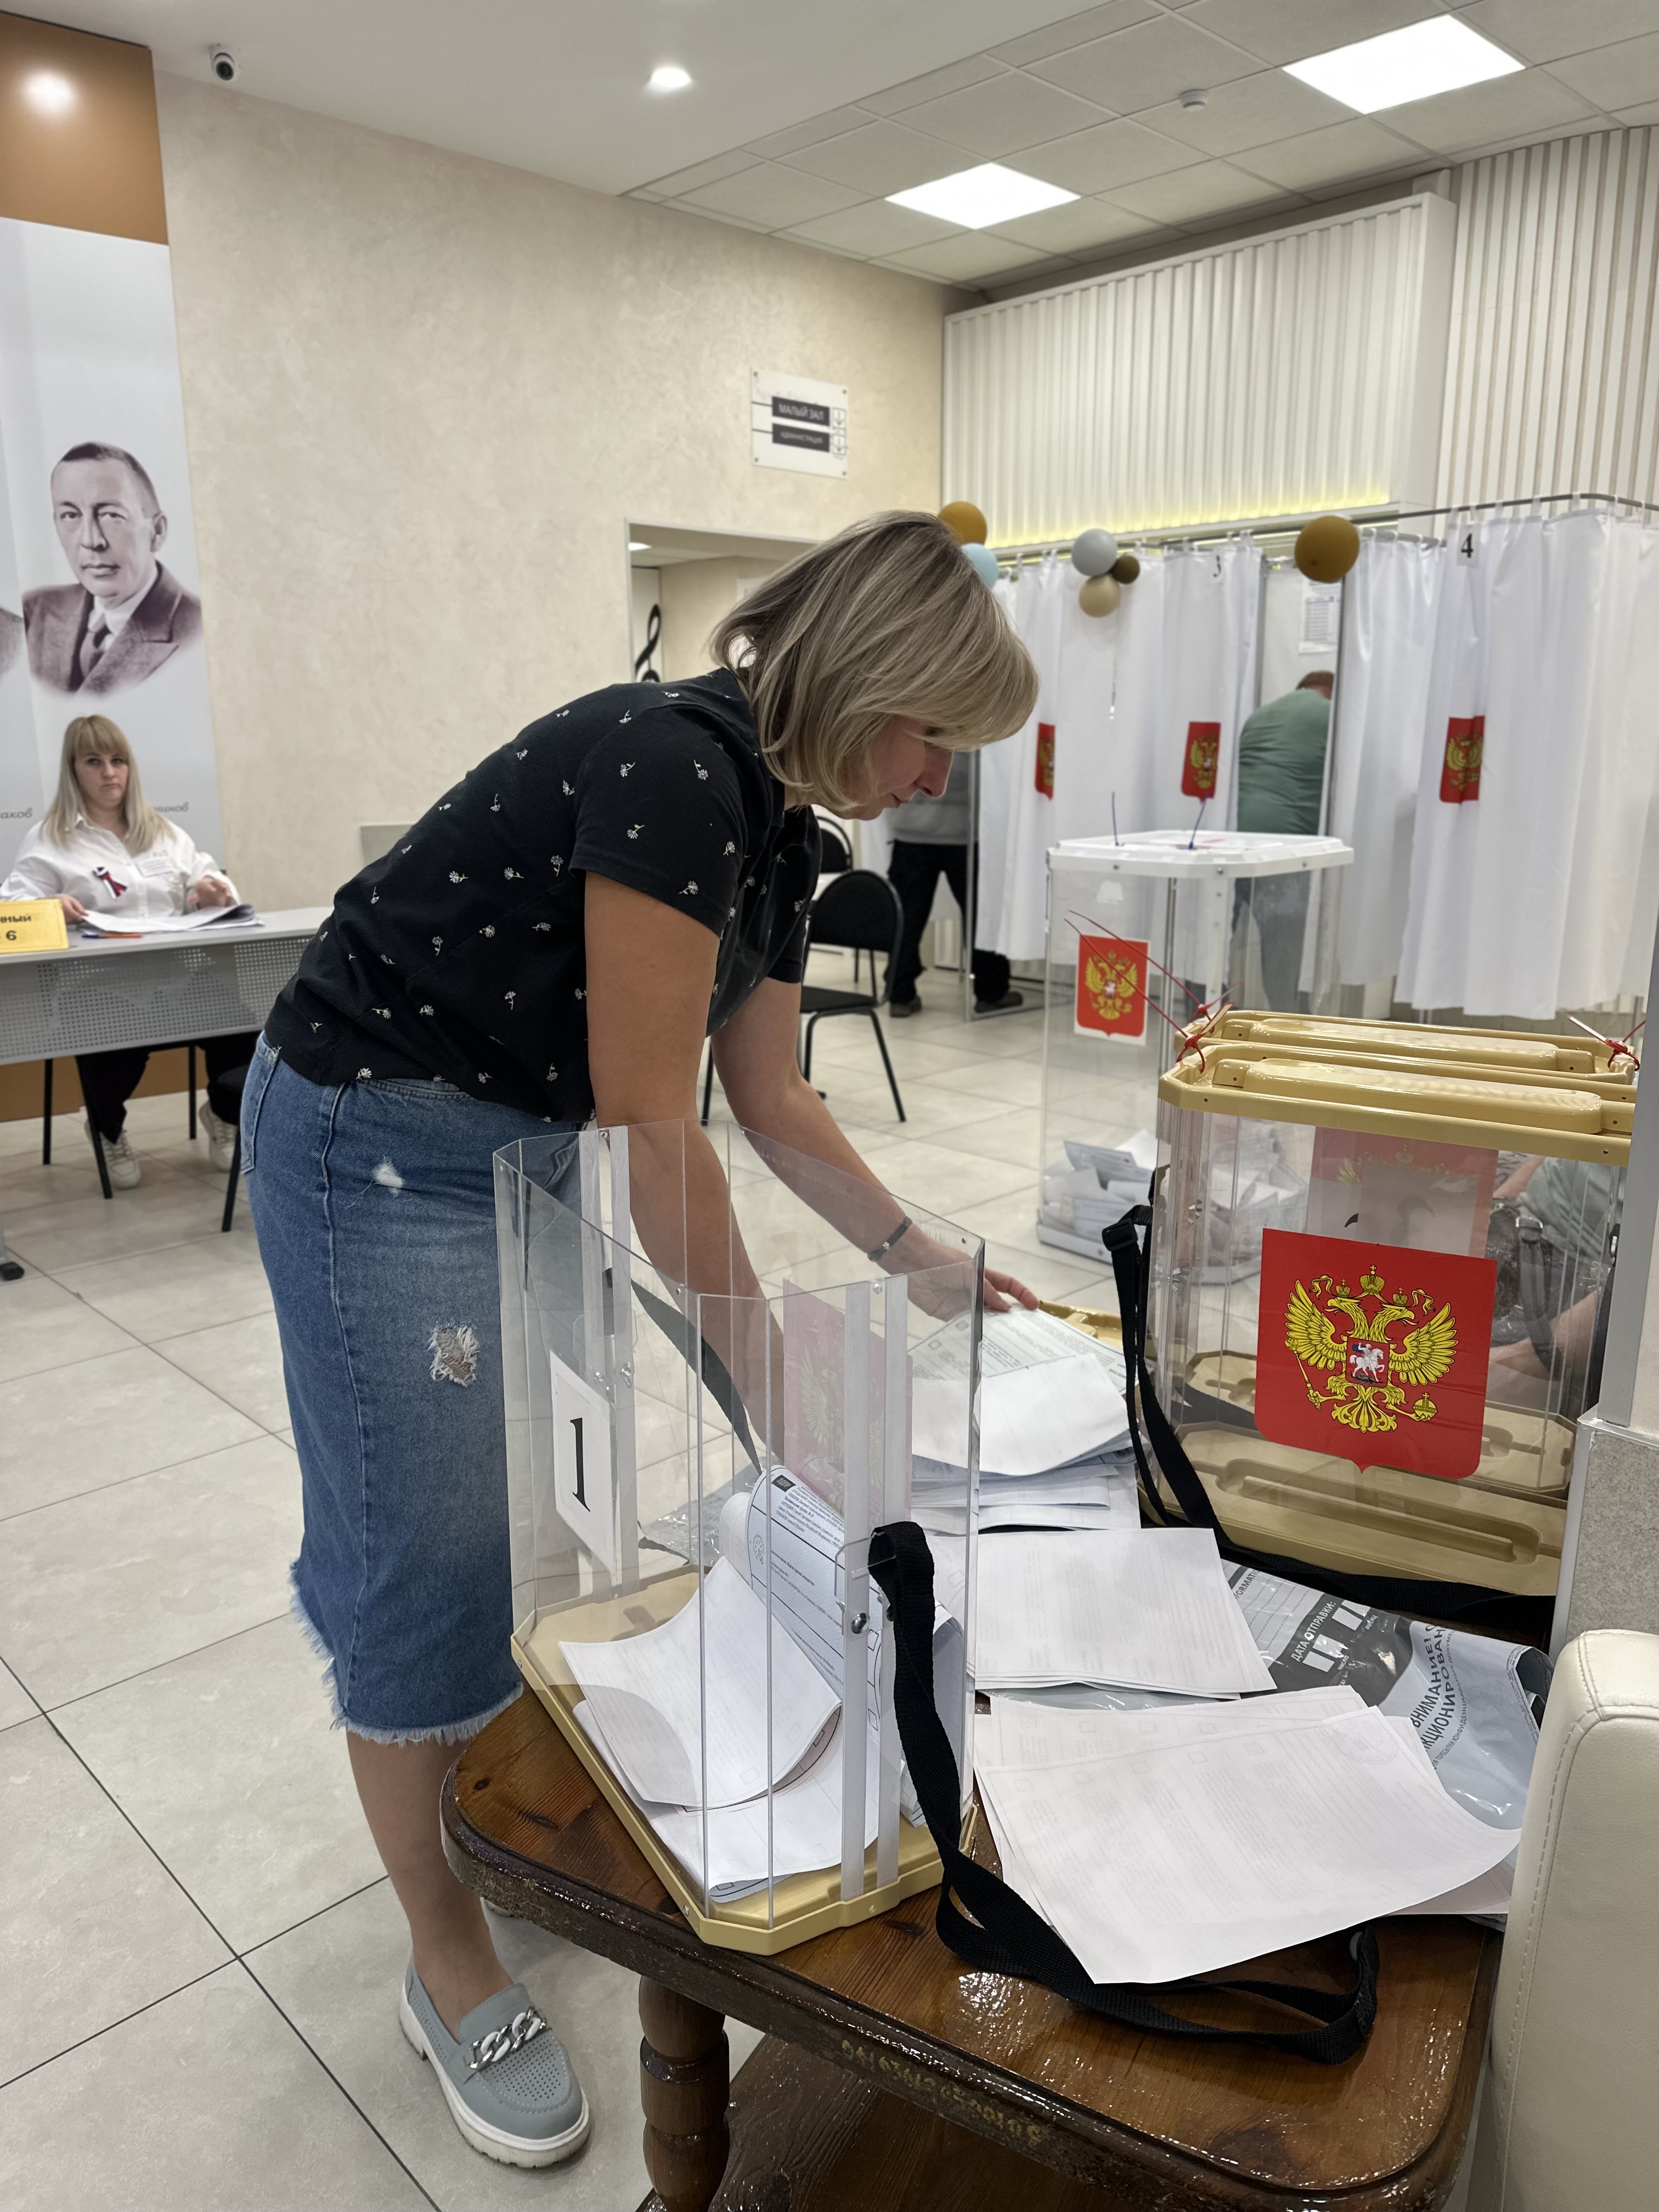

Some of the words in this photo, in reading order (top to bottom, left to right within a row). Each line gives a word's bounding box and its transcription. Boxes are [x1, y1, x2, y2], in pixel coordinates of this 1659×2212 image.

[779, 403, 808, 417] МАЛЫЙ
[809, 409, 824, 421] ЗАЛ
[1461, 533, 1474, 558] 4
[0, 808, 33, 819] аков
[5, 930, 17, 941] 6
[570, 1418, 590, 1512] 1
[1290, 1640, 1310, 1662] ДАТА
[1304, 1601, 1337, 1641] ОТПРАВКИ:
[1337, 1655, 1350, 1671] число
[1410, 1637, 1442, 1728] ВНИМАНИЕ!
[1450, 1665, 1468, 1743] КОНФИДЕНЦИАЛЬНЫХ
